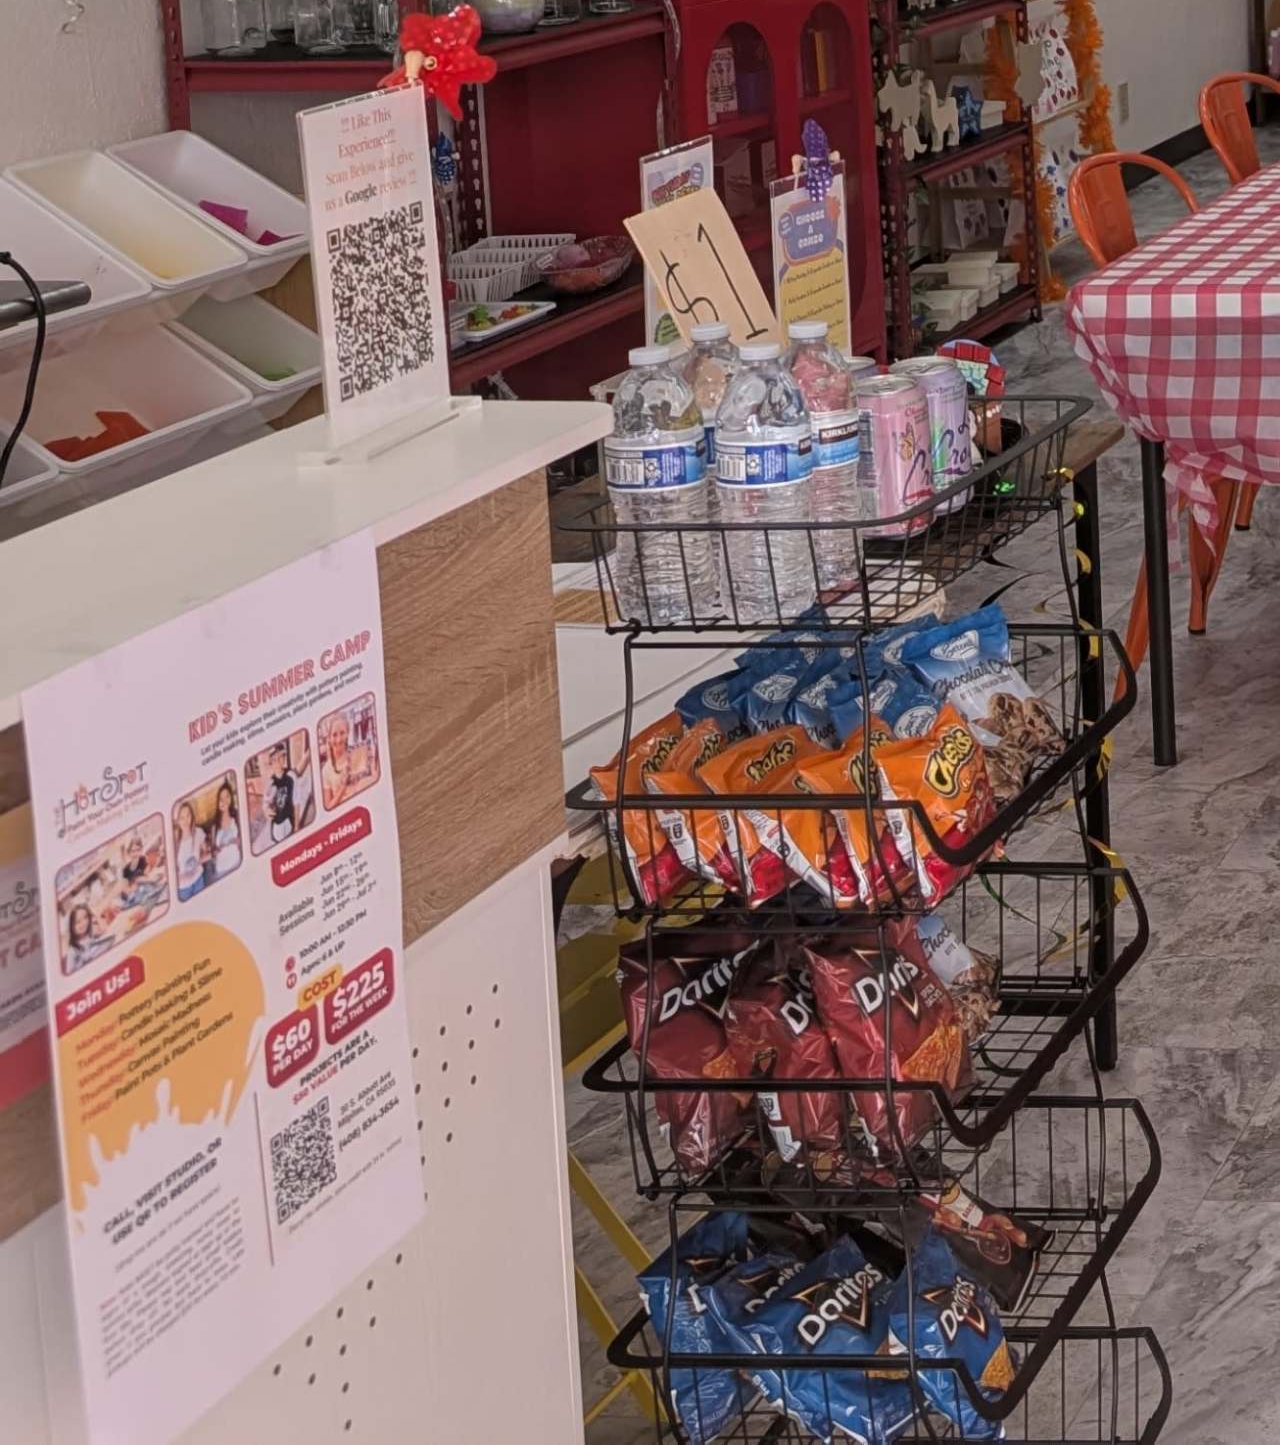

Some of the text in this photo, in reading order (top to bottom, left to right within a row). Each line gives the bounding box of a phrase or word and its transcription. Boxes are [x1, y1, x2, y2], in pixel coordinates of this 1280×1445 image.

[344, 183, 378, 204] Google
[189, 630, 371, 744] KID'S SUMMER CAMP
[279, 841, 323, 875] Mondays
[329, 818, 363, 846] Fridays
[278, 896, 314, 925] Available
[279, 909, 315, 937] Sessions
[65, 988, 102, 1021] Join
[105, 966, 131, 995] Us!
[303, 970, 337, 1002] COST
[332, 960, 385, 1019] $225
[331, 986, 389, 1034] FOR THE WEEK
[271, 1017, 312, 1062] $60
[272, 1038, 315, 1077] PER DAY
[299, 1047, 344, 1087] PROJECTS
[344, 1036, 362, 1055] ARE
[340, 1051, 357, 1070] PER
[135, 1180, 163, 1208] VISIT
[206, 1137, 222, 1154] OR
[170, 1156, 218, 1201] REGISTER
[798, 1262, 882, 1346] Doritos
